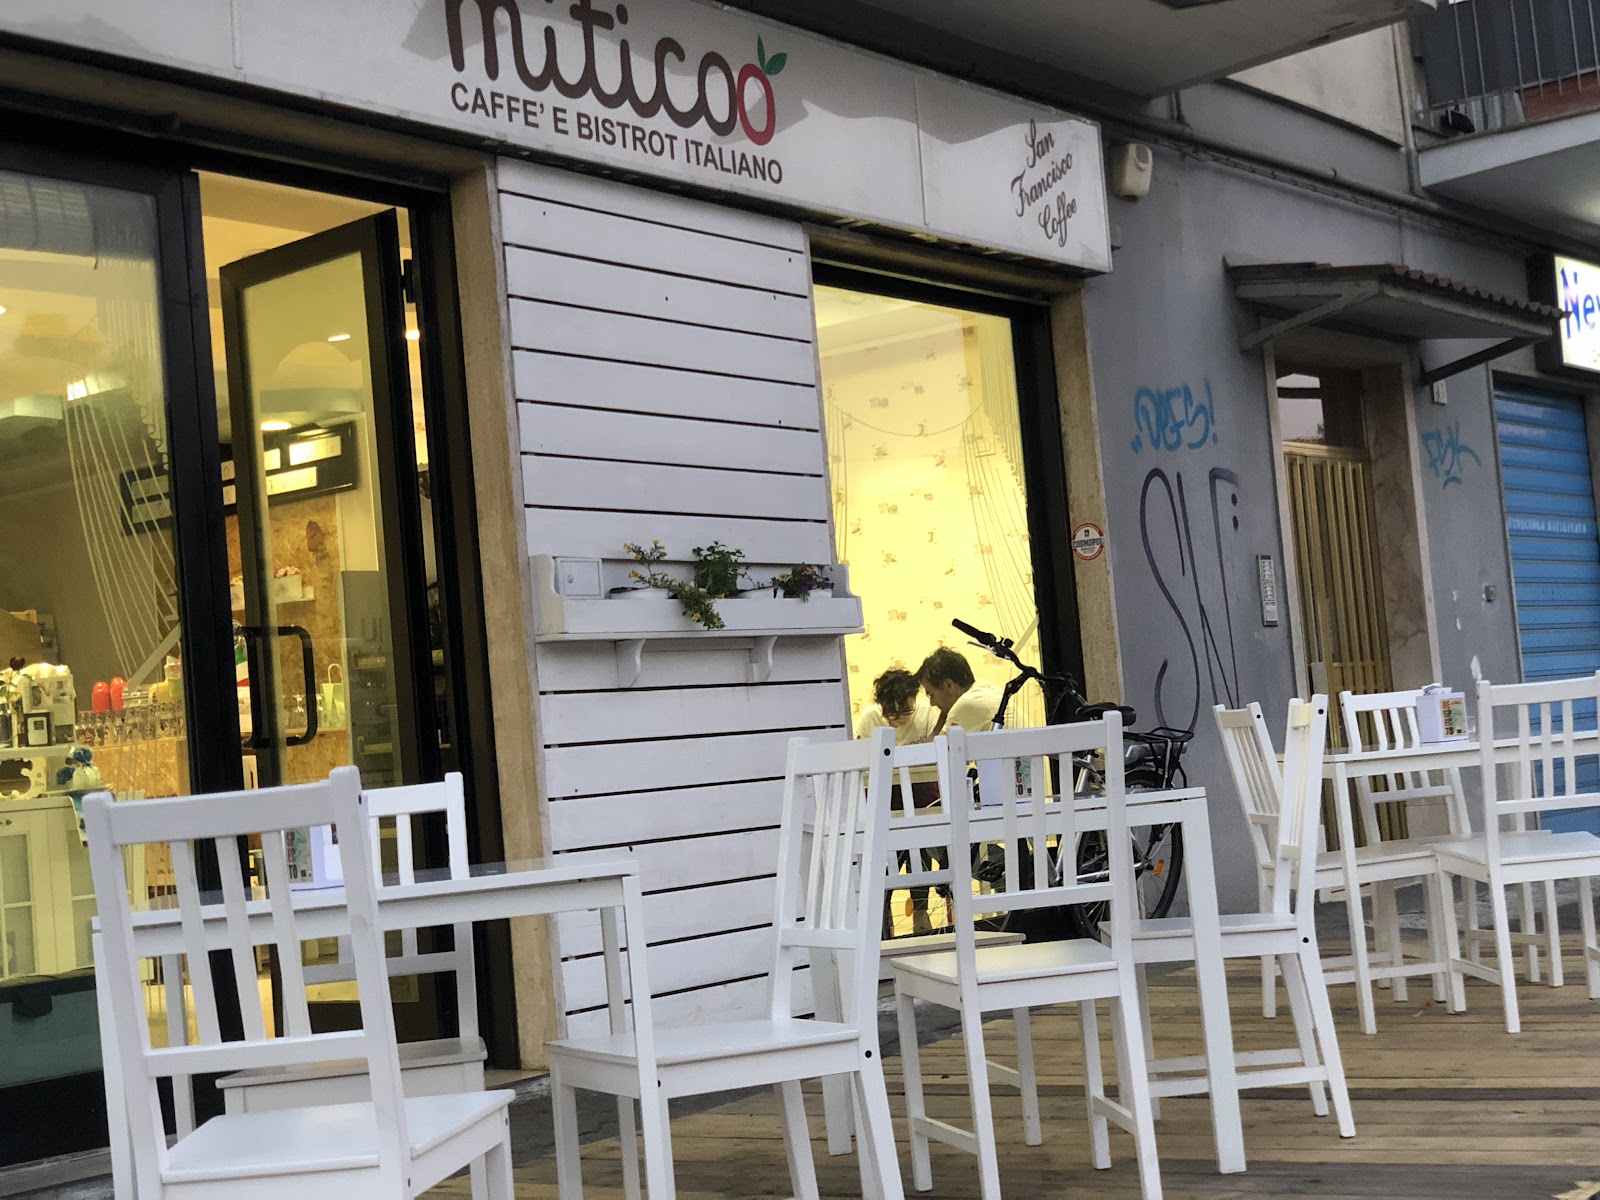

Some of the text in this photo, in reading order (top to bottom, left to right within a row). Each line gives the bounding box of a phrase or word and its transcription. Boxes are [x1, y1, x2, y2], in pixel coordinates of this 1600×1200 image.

[552, 106, 569, 135] E
[576, 112, 678, 159] BISTROT
[684, 138, 783, 185] ITALIANO
[1025, 118, 1055, 169] San
[1010, 153, 1072, 217] Francisco
[1038, 191, 1077, 248] Coffee
